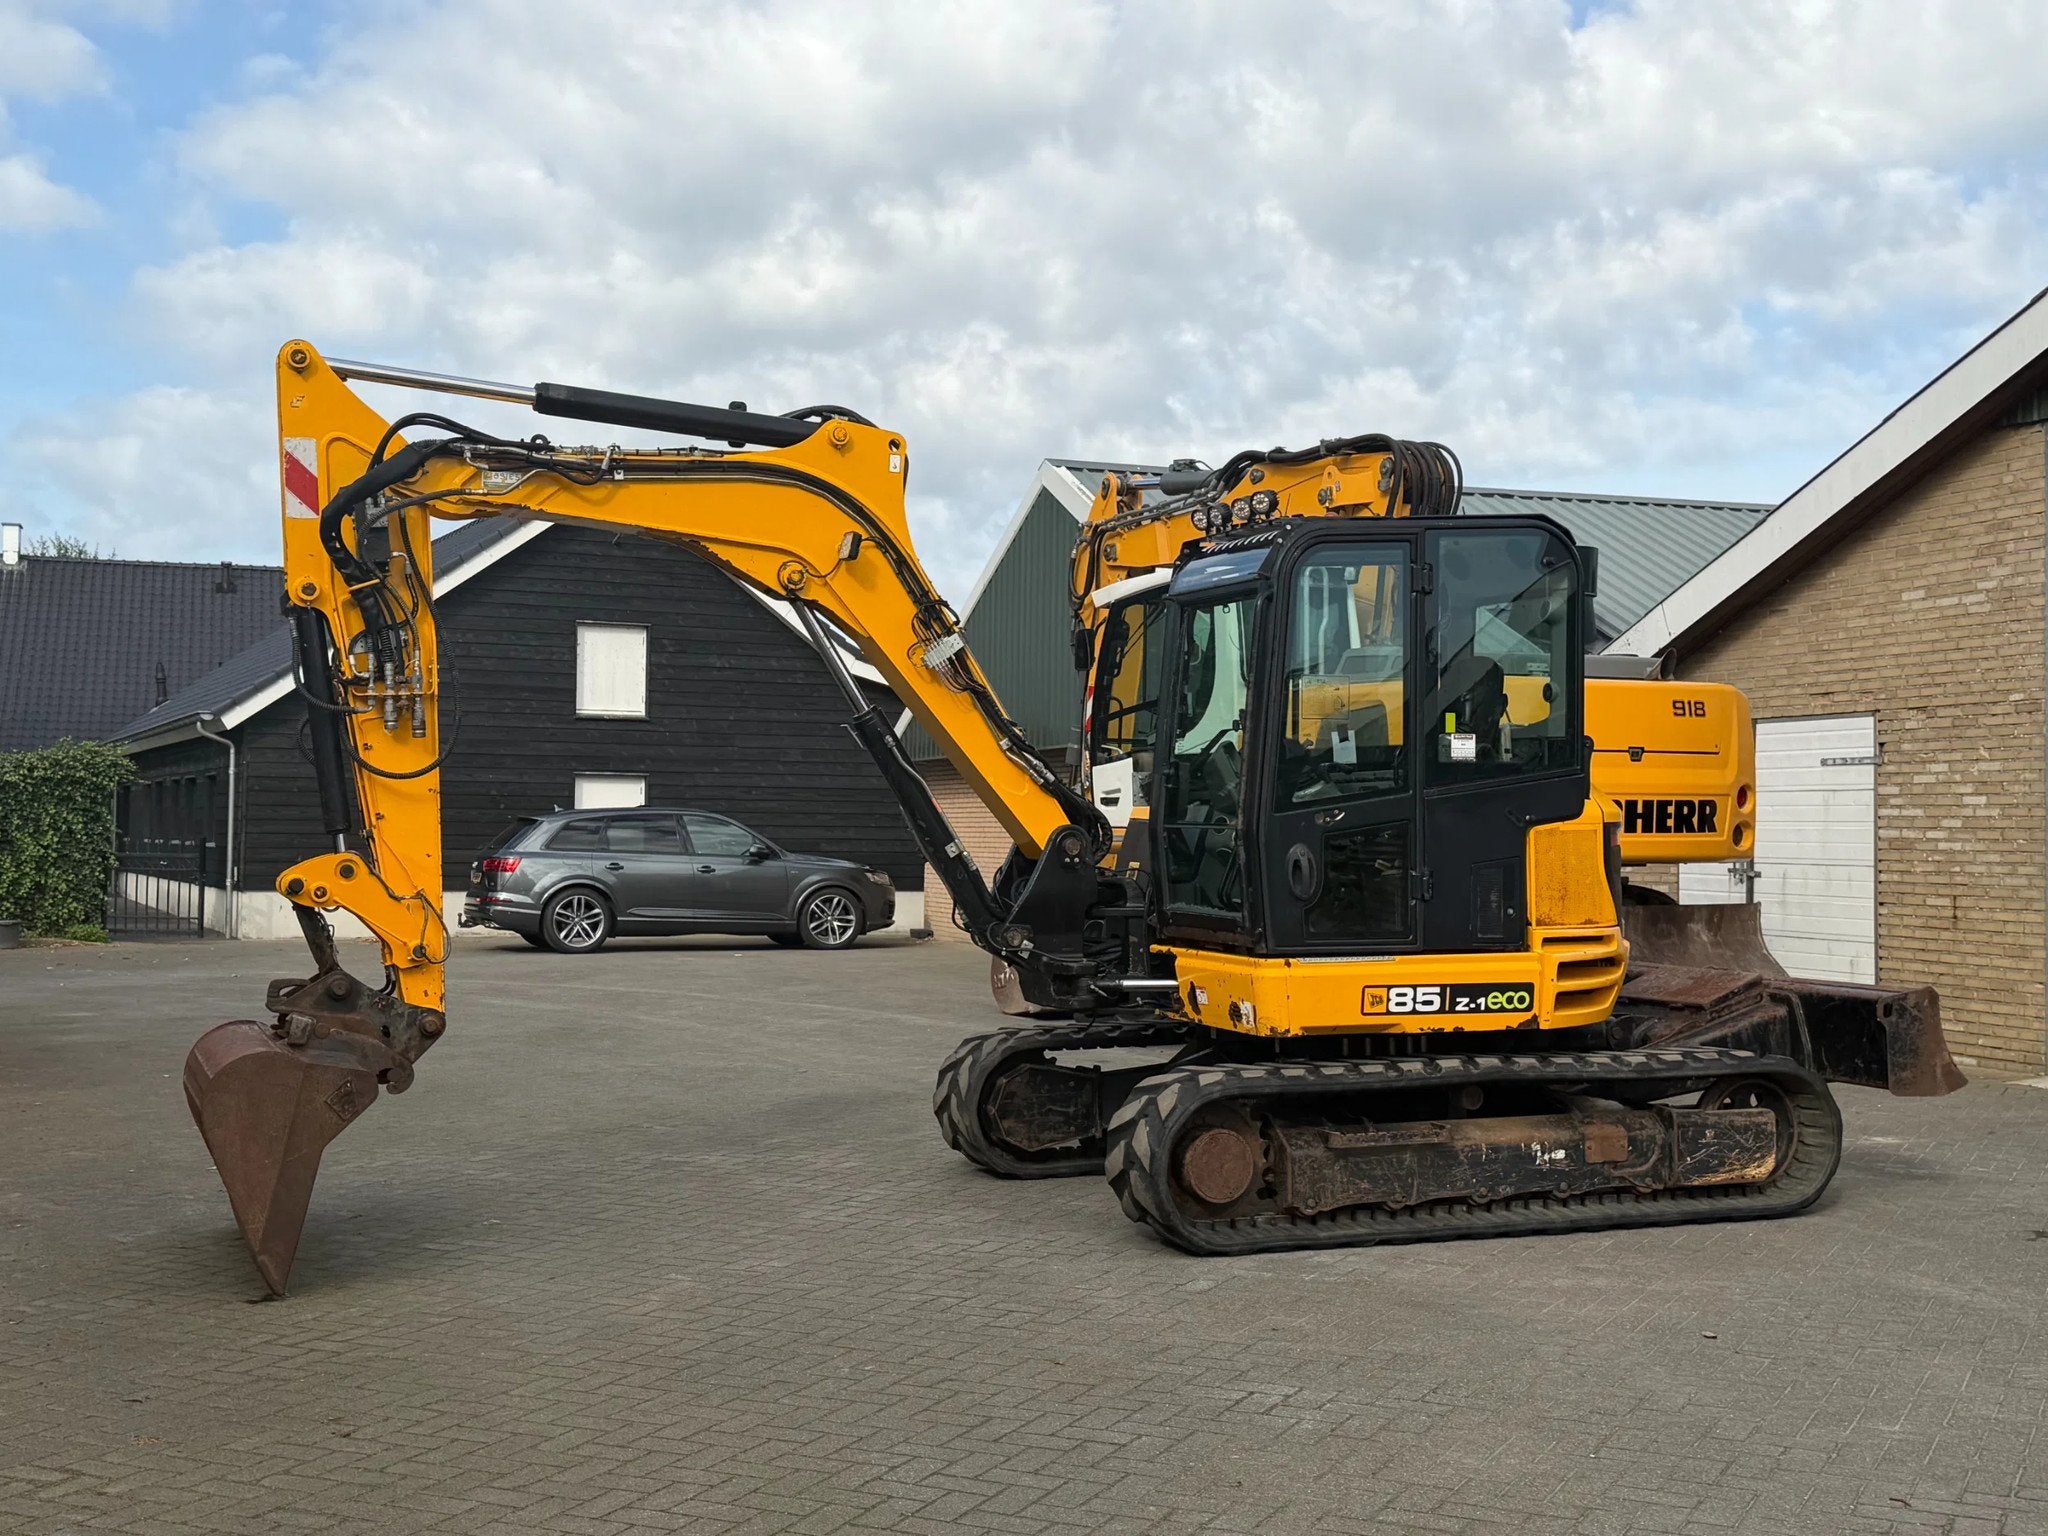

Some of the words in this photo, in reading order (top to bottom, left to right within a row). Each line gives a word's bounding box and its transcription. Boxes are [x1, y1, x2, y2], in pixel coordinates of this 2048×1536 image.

[1674, 701, 1706, 717] 918
[1613, 800, 1717, 833] HERR
[1388, 986, 1442, 1013] 85
